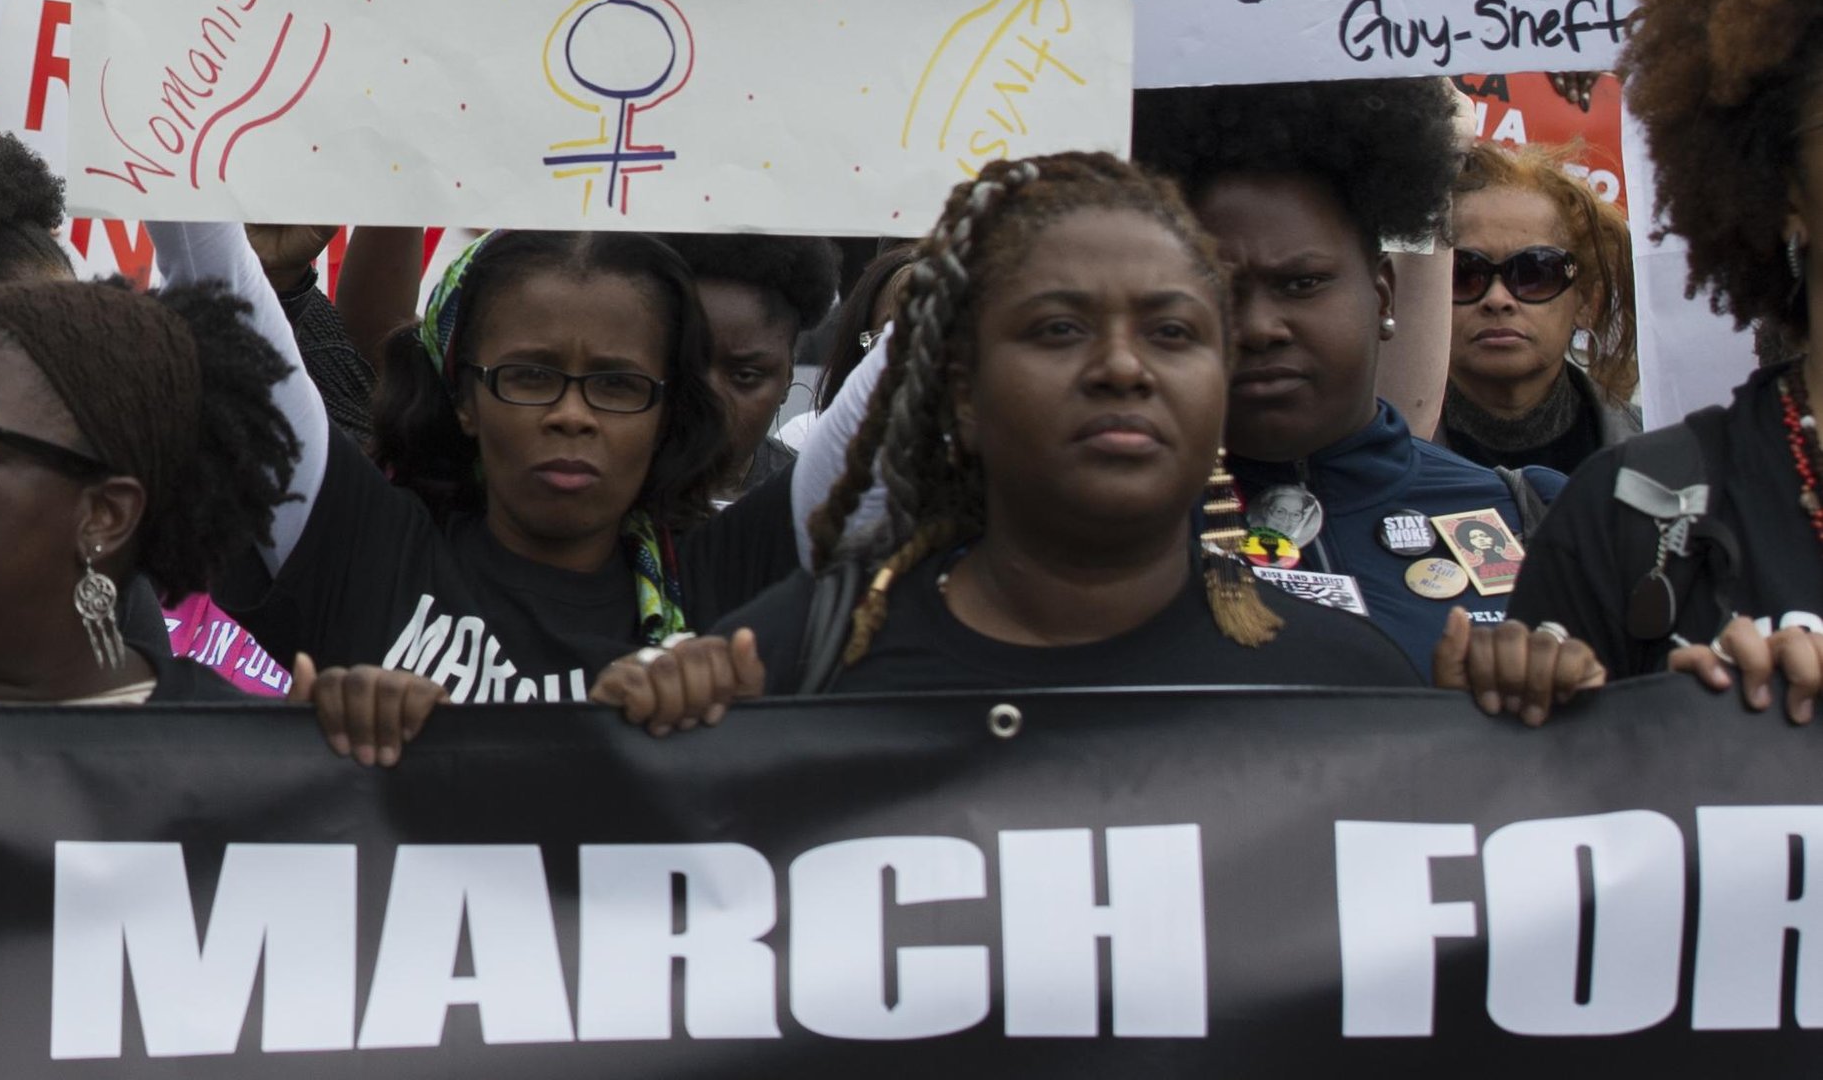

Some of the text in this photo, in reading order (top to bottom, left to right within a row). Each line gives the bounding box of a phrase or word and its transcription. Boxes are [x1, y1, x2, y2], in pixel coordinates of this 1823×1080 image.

[1383, 515, 1426, 531] STAY
[1386, 528, 1431, 543] WOKE
[1287, 571, 1309, 583] AND
[382, 594, 587, 703] MAR
[50, 805, 1823, 1060] MARCH FOR
